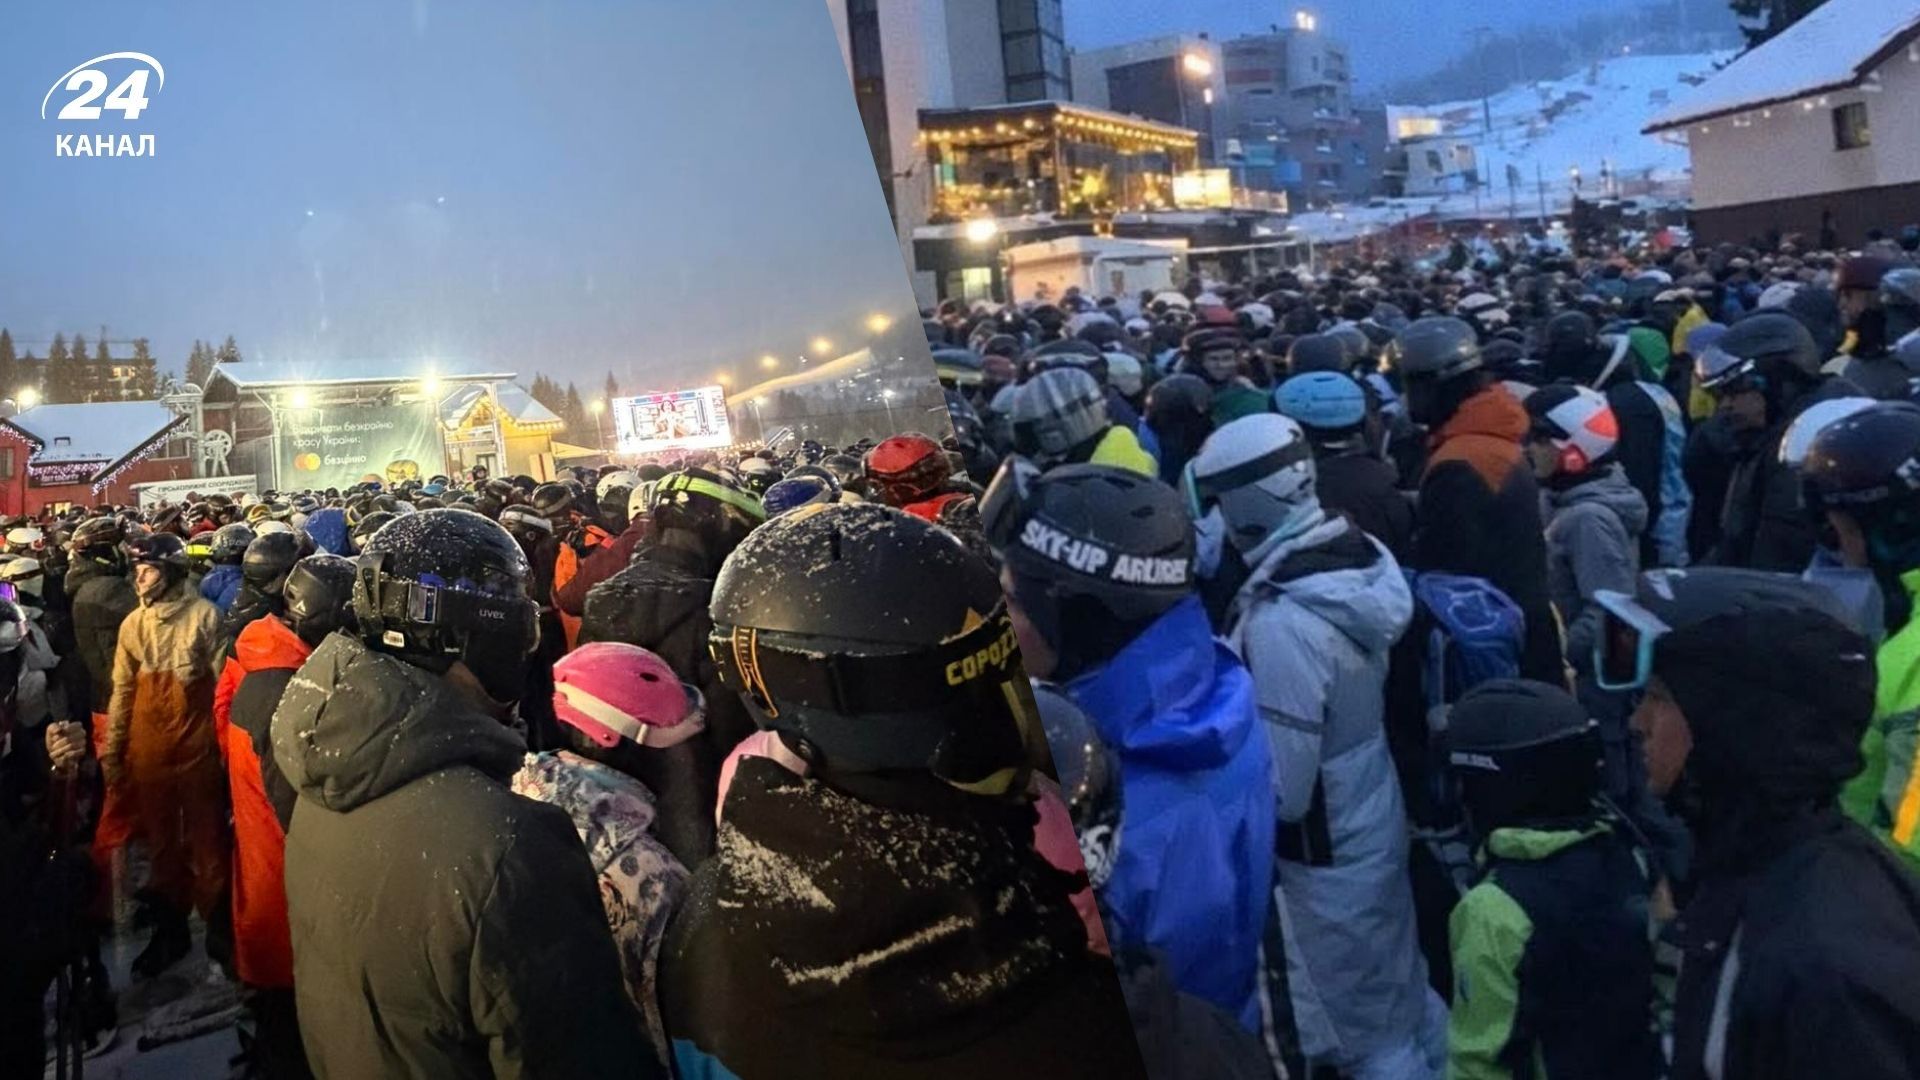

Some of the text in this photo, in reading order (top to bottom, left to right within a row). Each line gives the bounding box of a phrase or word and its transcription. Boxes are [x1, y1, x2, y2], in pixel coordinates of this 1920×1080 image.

[293, 438, 321, 449] красу
[324, 454, 367, 465] безцінно
[1020, 519, 1108, 574] SKY-UP
[479, 608, 505, 619] uvex
